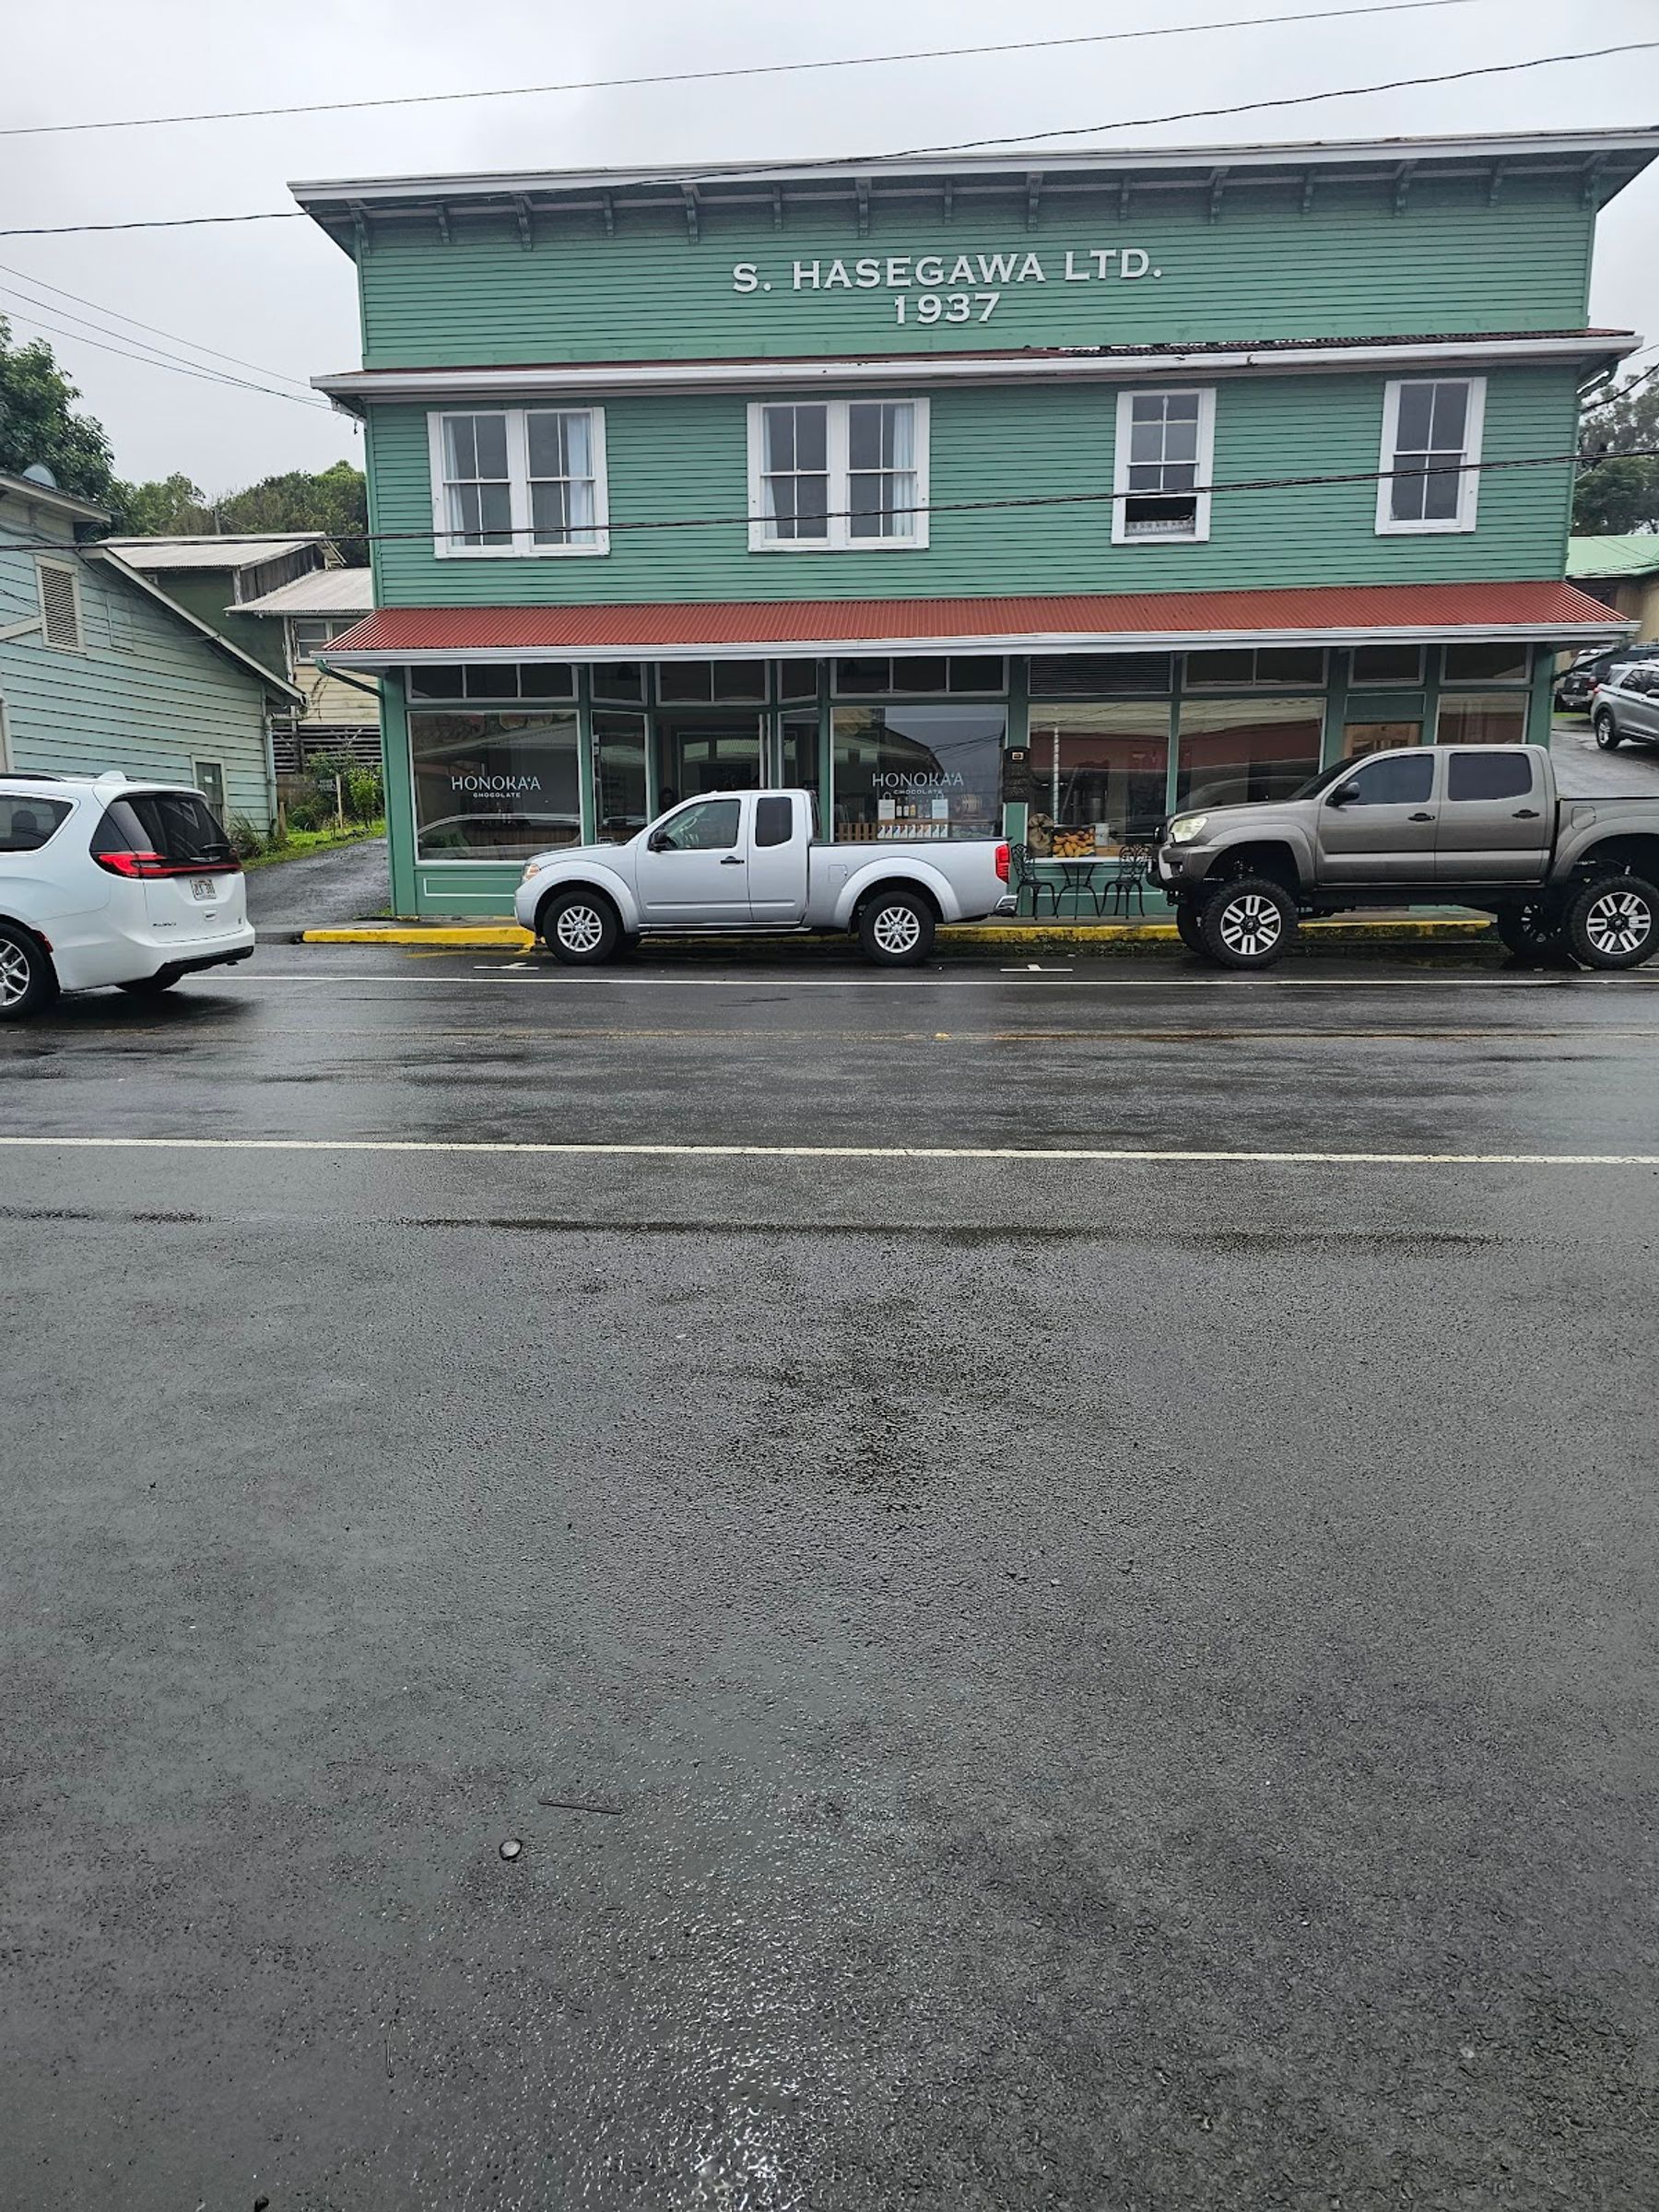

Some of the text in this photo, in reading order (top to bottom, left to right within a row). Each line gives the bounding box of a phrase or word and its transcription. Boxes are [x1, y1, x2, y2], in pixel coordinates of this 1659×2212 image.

[733, 248, 1162, 292] S. HASEGAWA LTD.
[894, 292, 1001, 325] 1937
